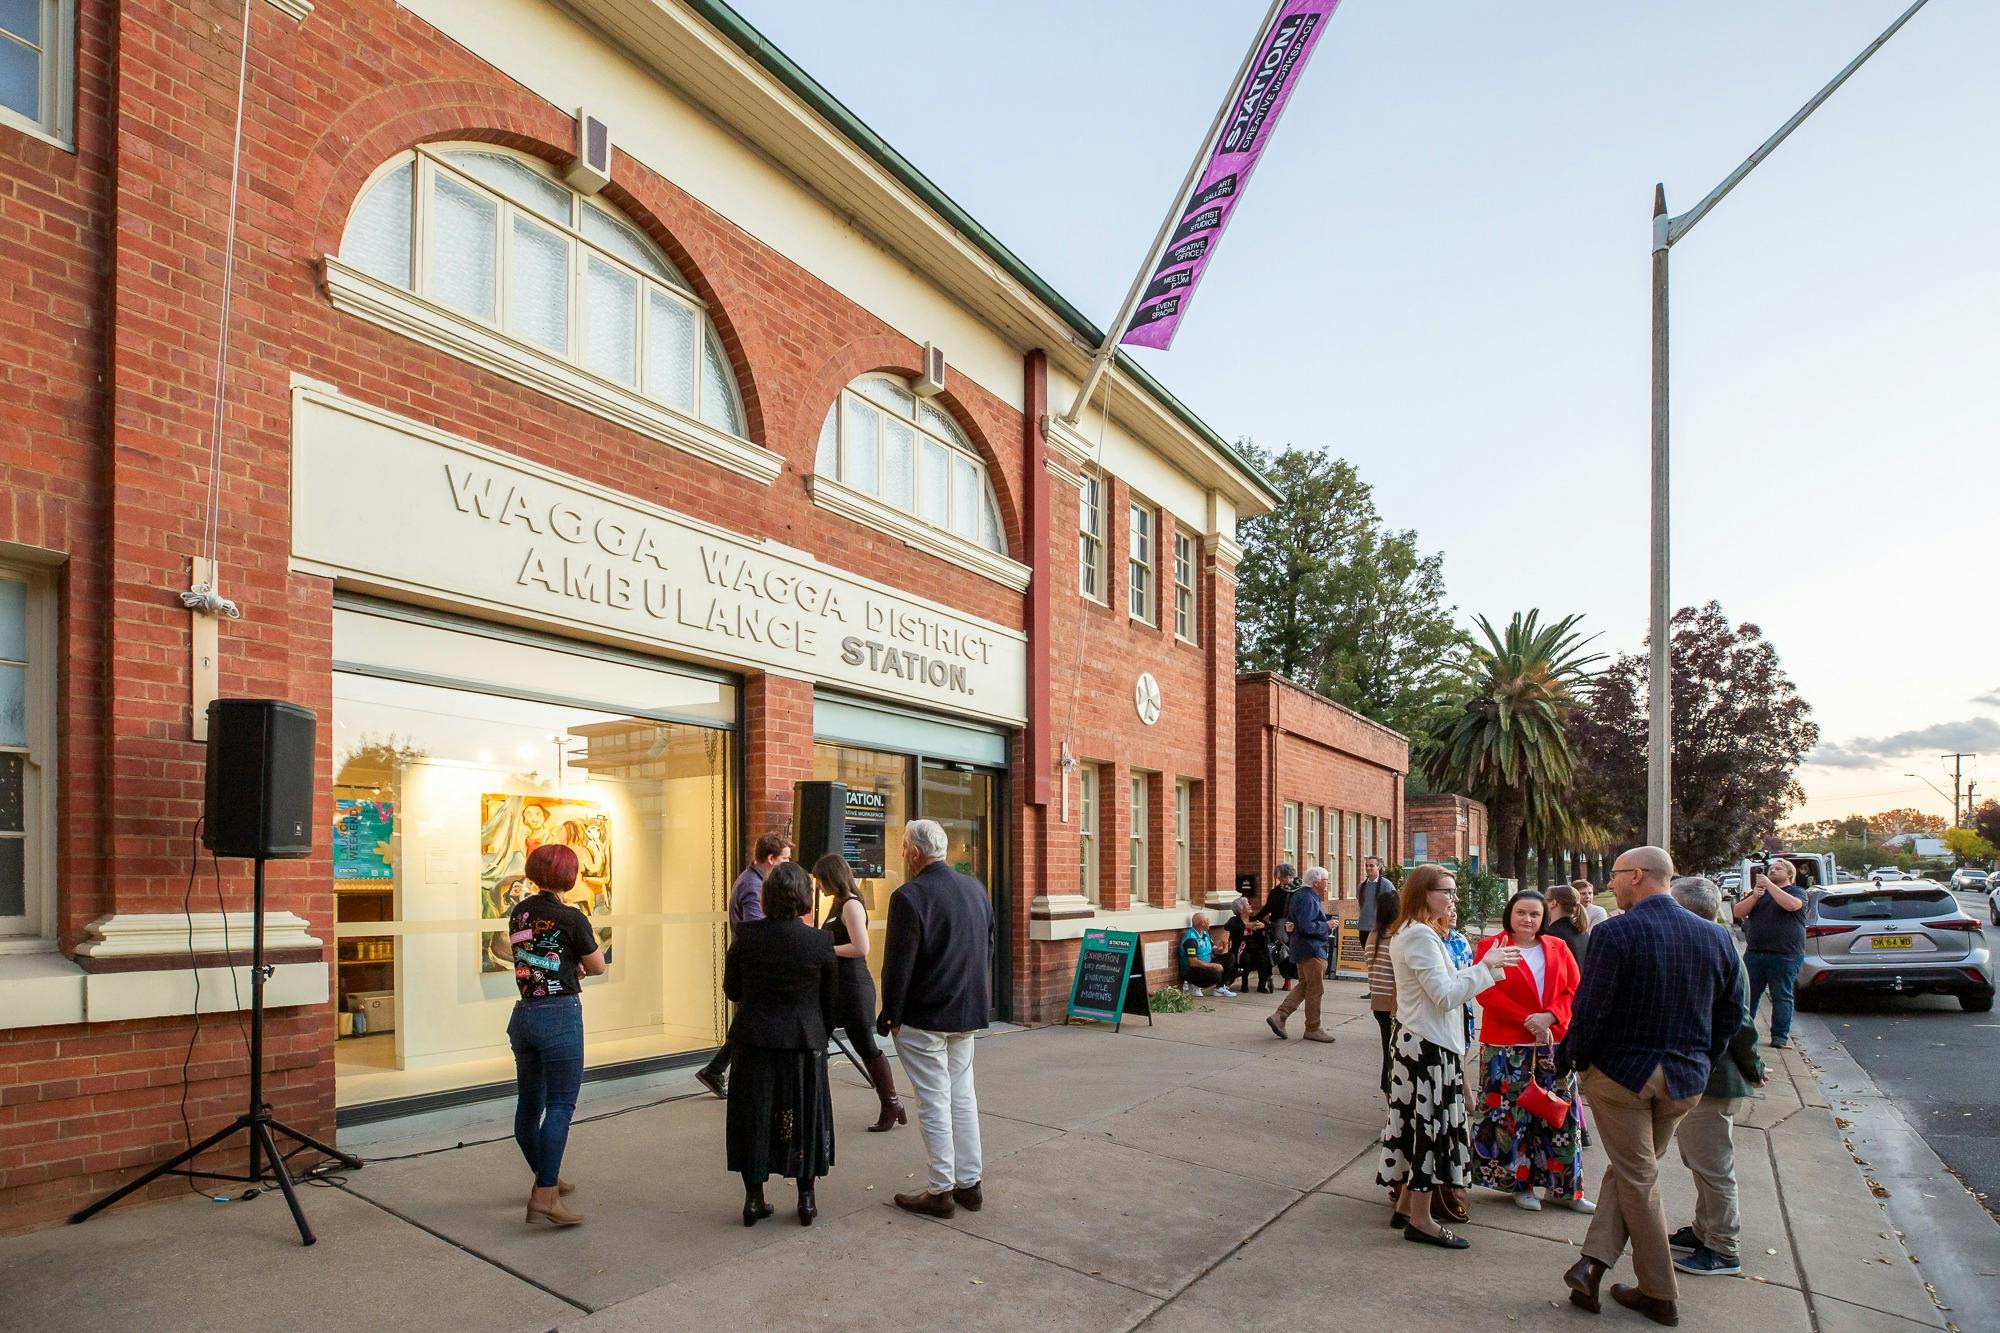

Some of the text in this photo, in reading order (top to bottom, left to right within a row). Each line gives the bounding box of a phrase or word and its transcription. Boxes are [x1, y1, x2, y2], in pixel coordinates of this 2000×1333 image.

[1225, 18, 1302, 148] STATION.
[1242, 18, 1316, 148] CREATIVE WORKSPACE
[1217, 178, 1232, 190] ART
[1203, 186, 1233, 203] GALLERY
[1195, 210, 1219, 223] ARTIST
[1189, 218, 1218, 232] STUDIOS
[1175, 240, 1206, 256] CREATIVE
[1155, 299, 1178, 311] EVENT
[445, 464, 993, 664] WAGGA WAGGA DISTRICT
[516, 548, 975, 696] AMBULANCE STATION.
[846, 792, 884, 807] TATION.
